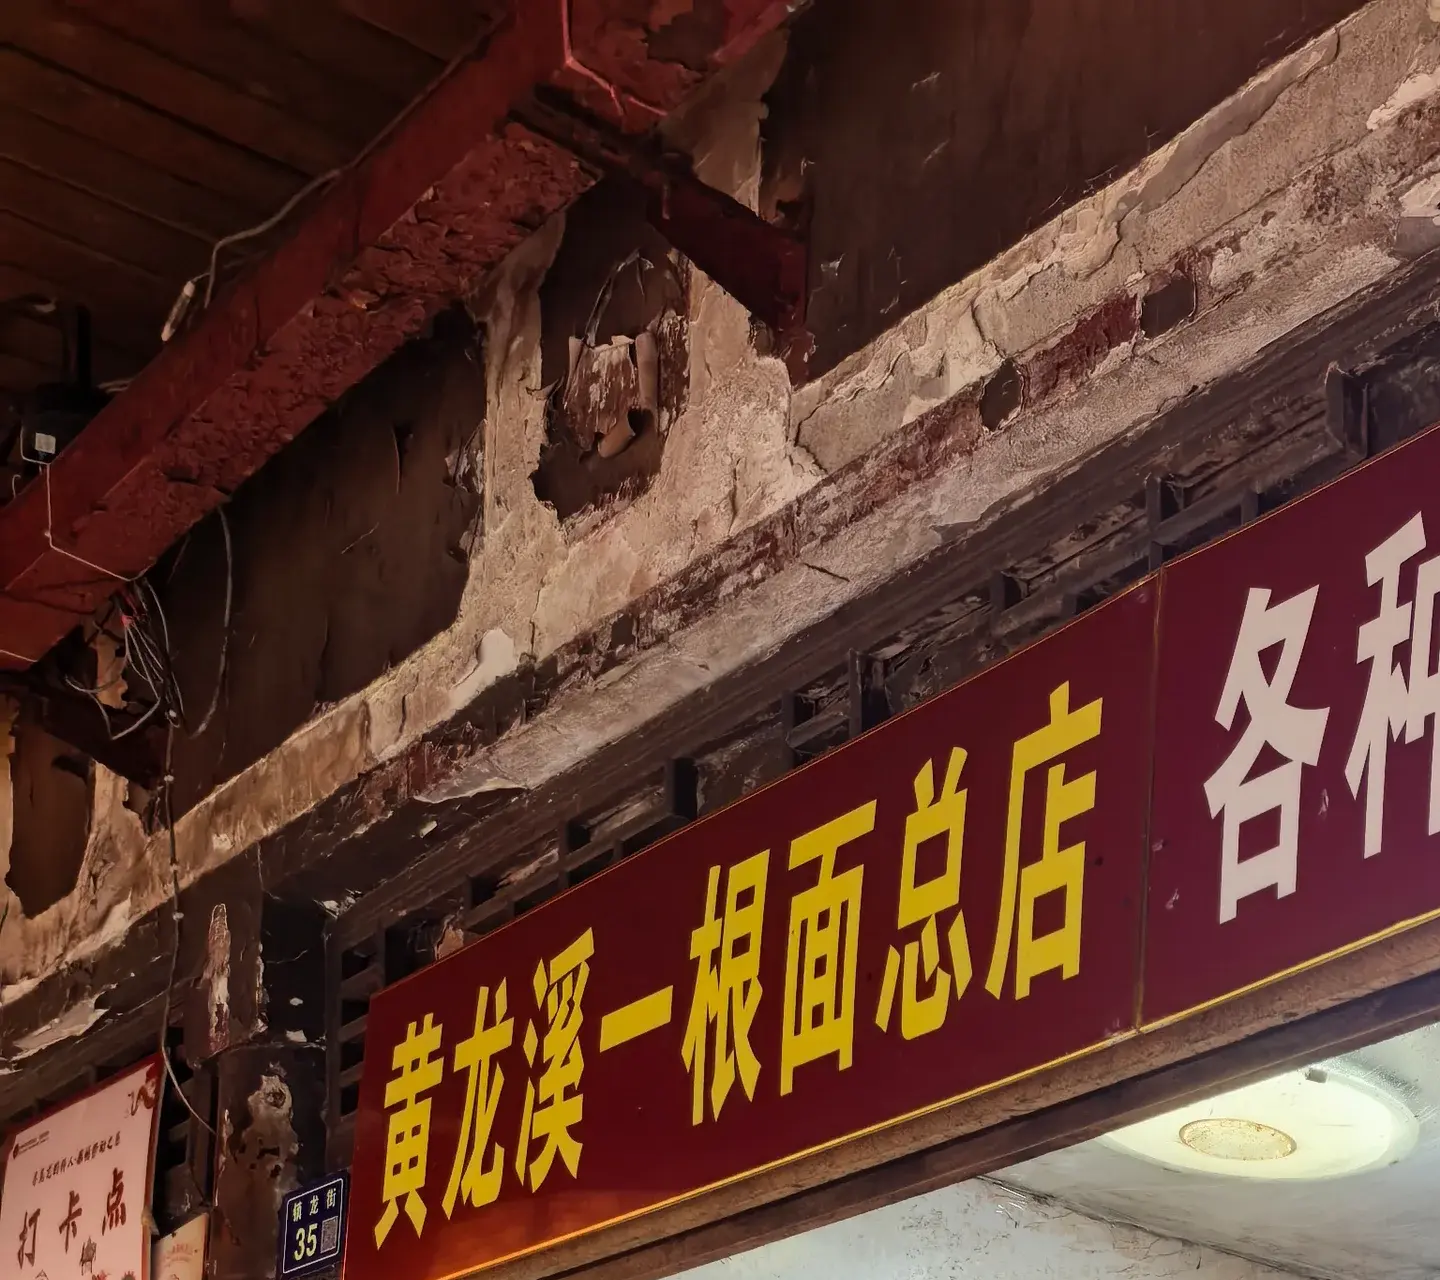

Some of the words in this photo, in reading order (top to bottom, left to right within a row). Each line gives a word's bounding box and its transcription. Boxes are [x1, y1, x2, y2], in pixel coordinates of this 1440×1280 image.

[375, 681, 1103, 1248] 黄龙溪一根面总店
[18, 1167, 126, 1269] 打卡点
[294, 1223, 318, 1260] 35
